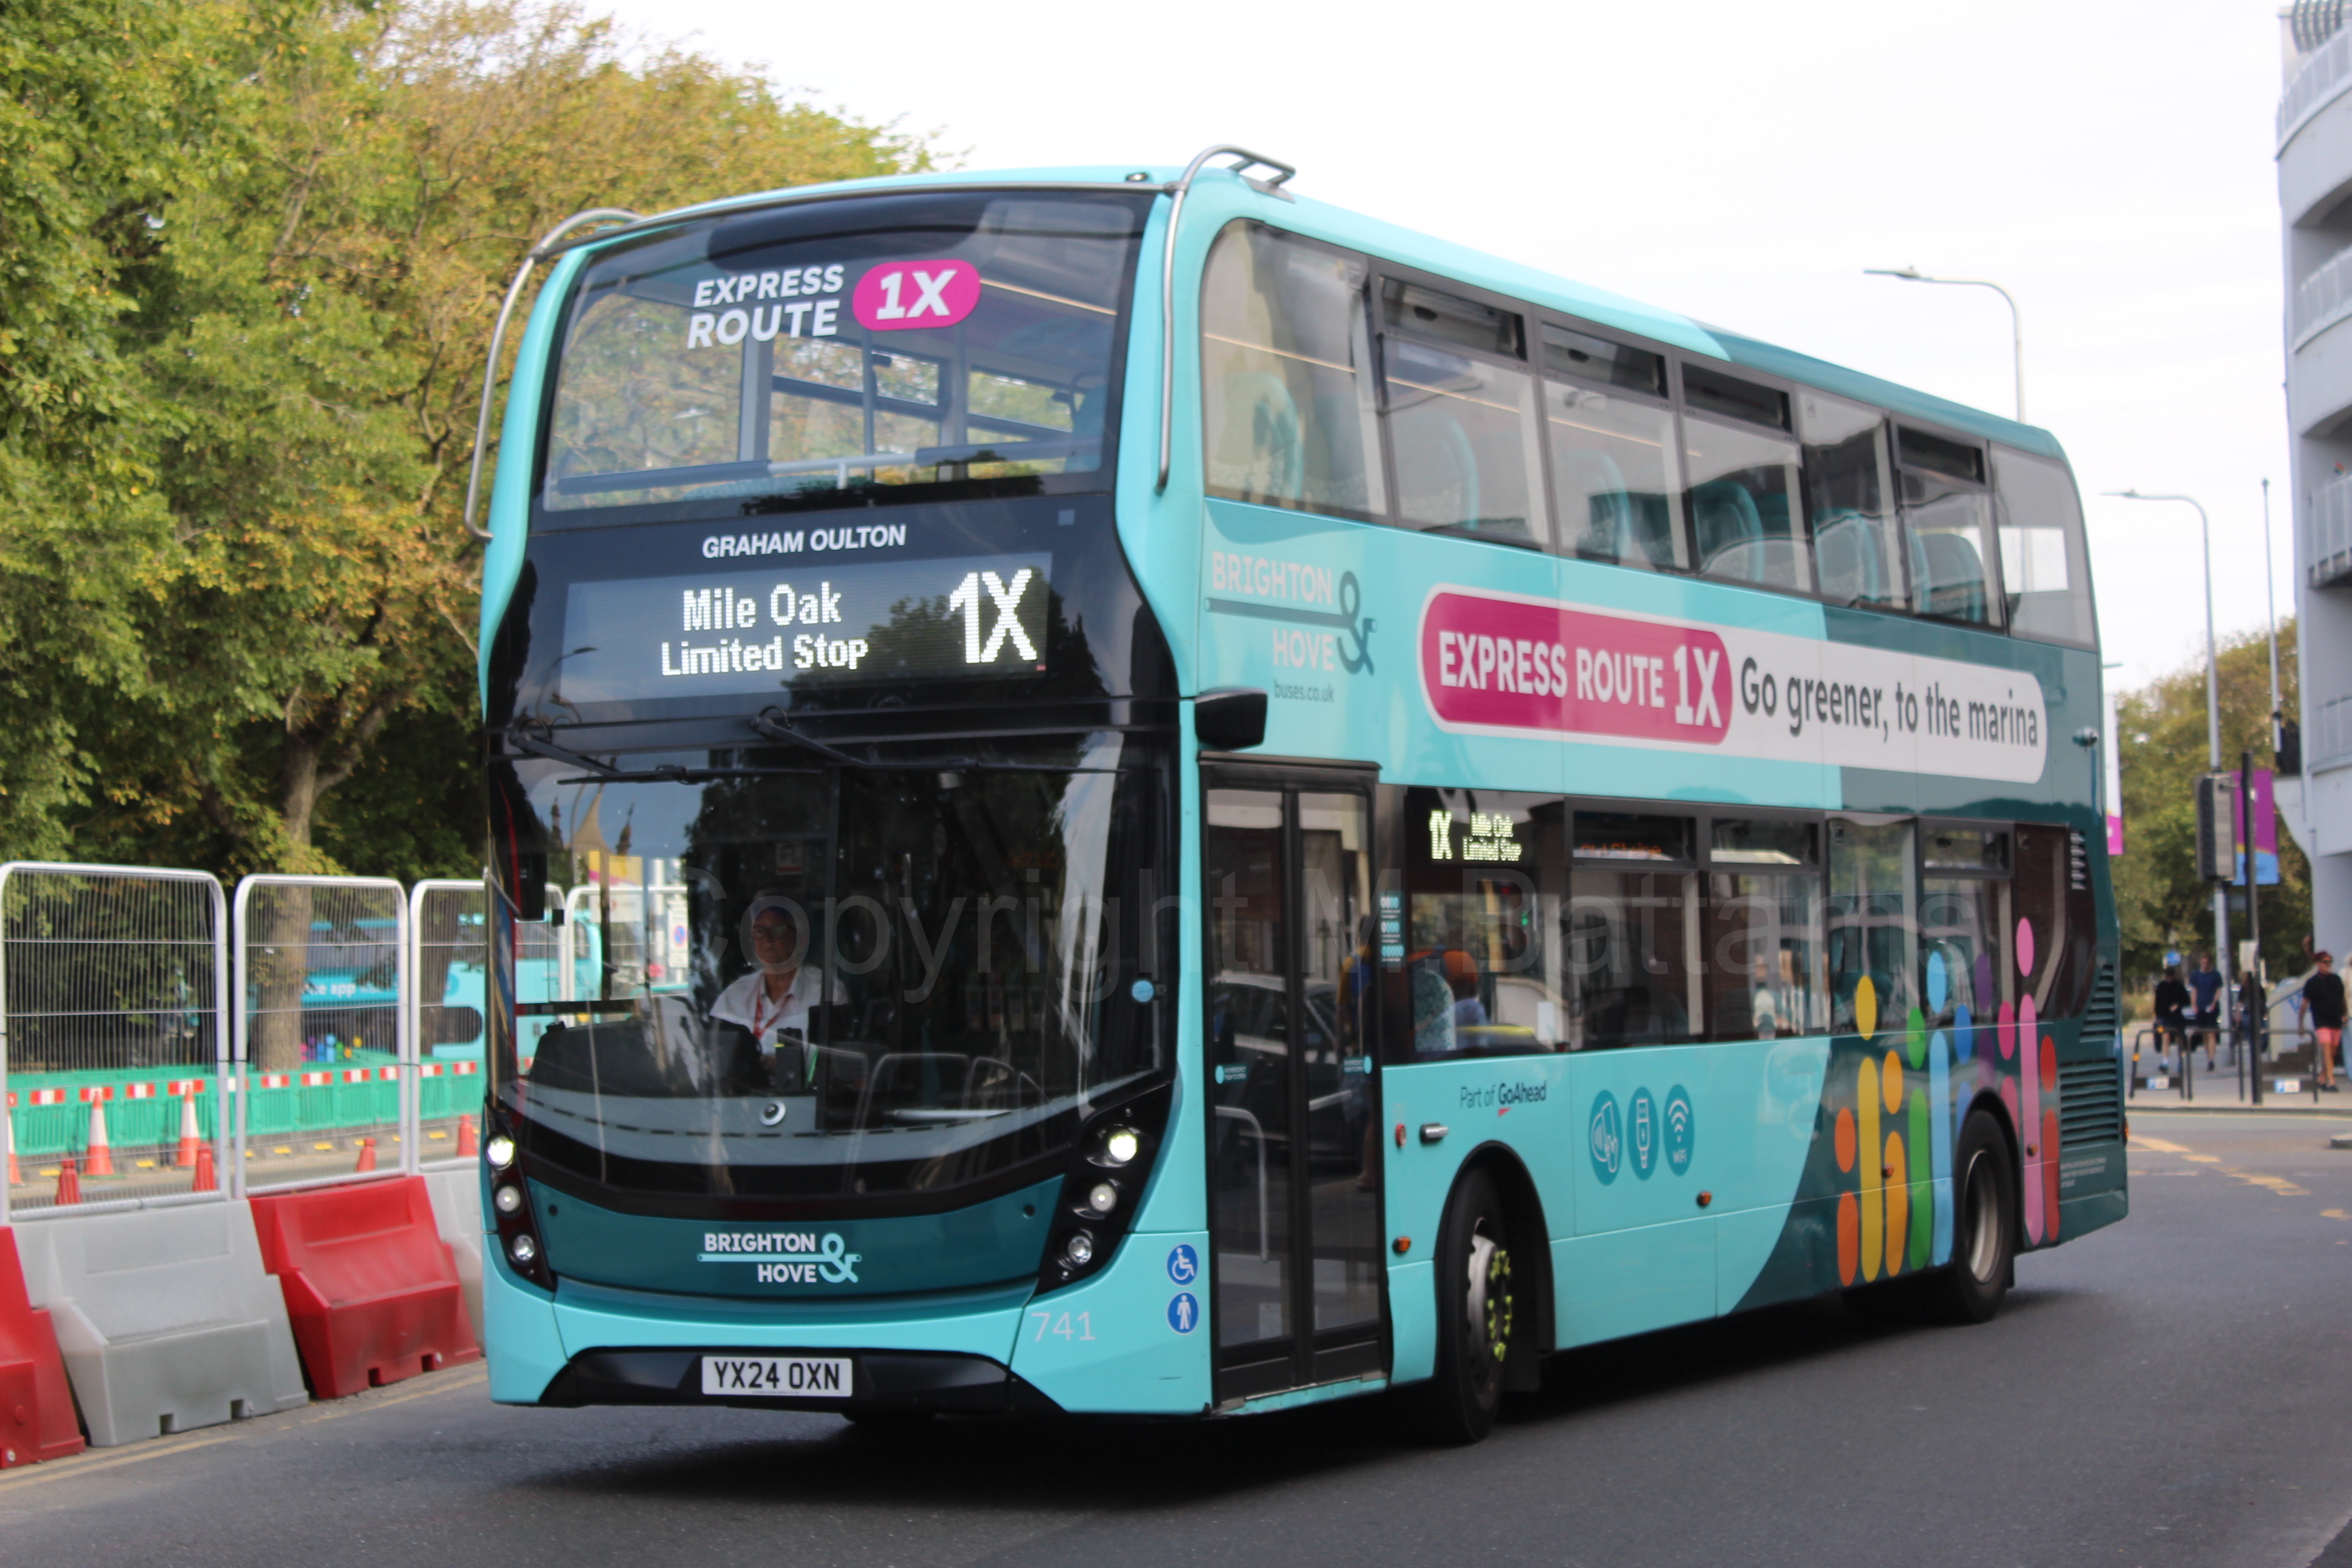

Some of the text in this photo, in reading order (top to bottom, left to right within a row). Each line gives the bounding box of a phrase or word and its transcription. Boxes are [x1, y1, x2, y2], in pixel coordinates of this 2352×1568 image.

[693, 265, 844, 308] EXPRESS
[687, 268, 958, 350] ROUTE 1X
[702, 524, 907, 559] GRAHAM OULTON
[1212, 551, 1332, 604] BRIGHTON
[683, 569, 1037, 664] Mile Oak 1X
[662, 634, 868, 676] Limited Stop
[1273, 630, 1335, 672] HOVE
[1274, 680, 1335, 703] buses.co.uk
[1438, 630, 2039, 748] EXPRESS ROUTE 1X Go greener, to the marina
[1460, 1081, 1546, 1108] Part of GoAhead
[704, 1233, 815, 1252] BRIGHTON
[757, 1264, 817, 1283] HOVE
[1031, 1312, 1096, 1341] 741
[714, 1362, 780, 1389] YX24
